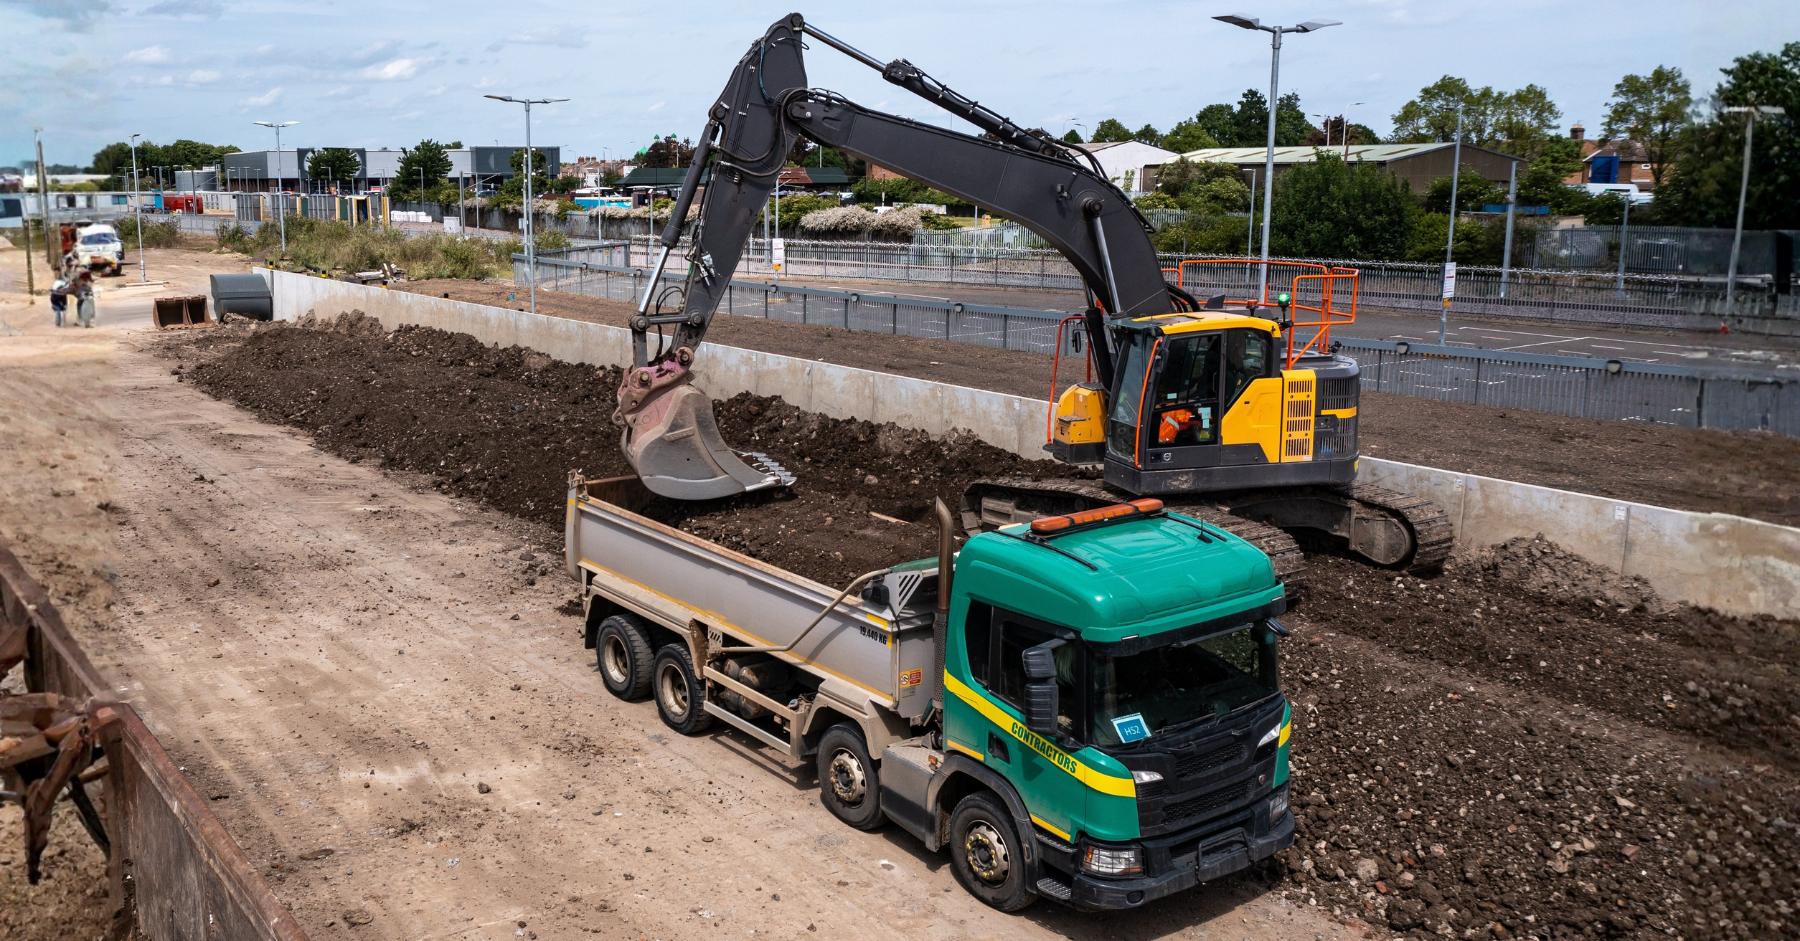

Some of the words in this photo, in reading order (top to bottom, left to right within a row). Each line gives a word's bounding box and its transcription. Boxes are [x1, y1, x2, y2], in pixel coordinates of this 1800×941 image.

[879, 633, 887, 645] KG
[1124, 725, 1141, 736] HS2
[1011, 722, 1077, 773] CONTRACTORS
